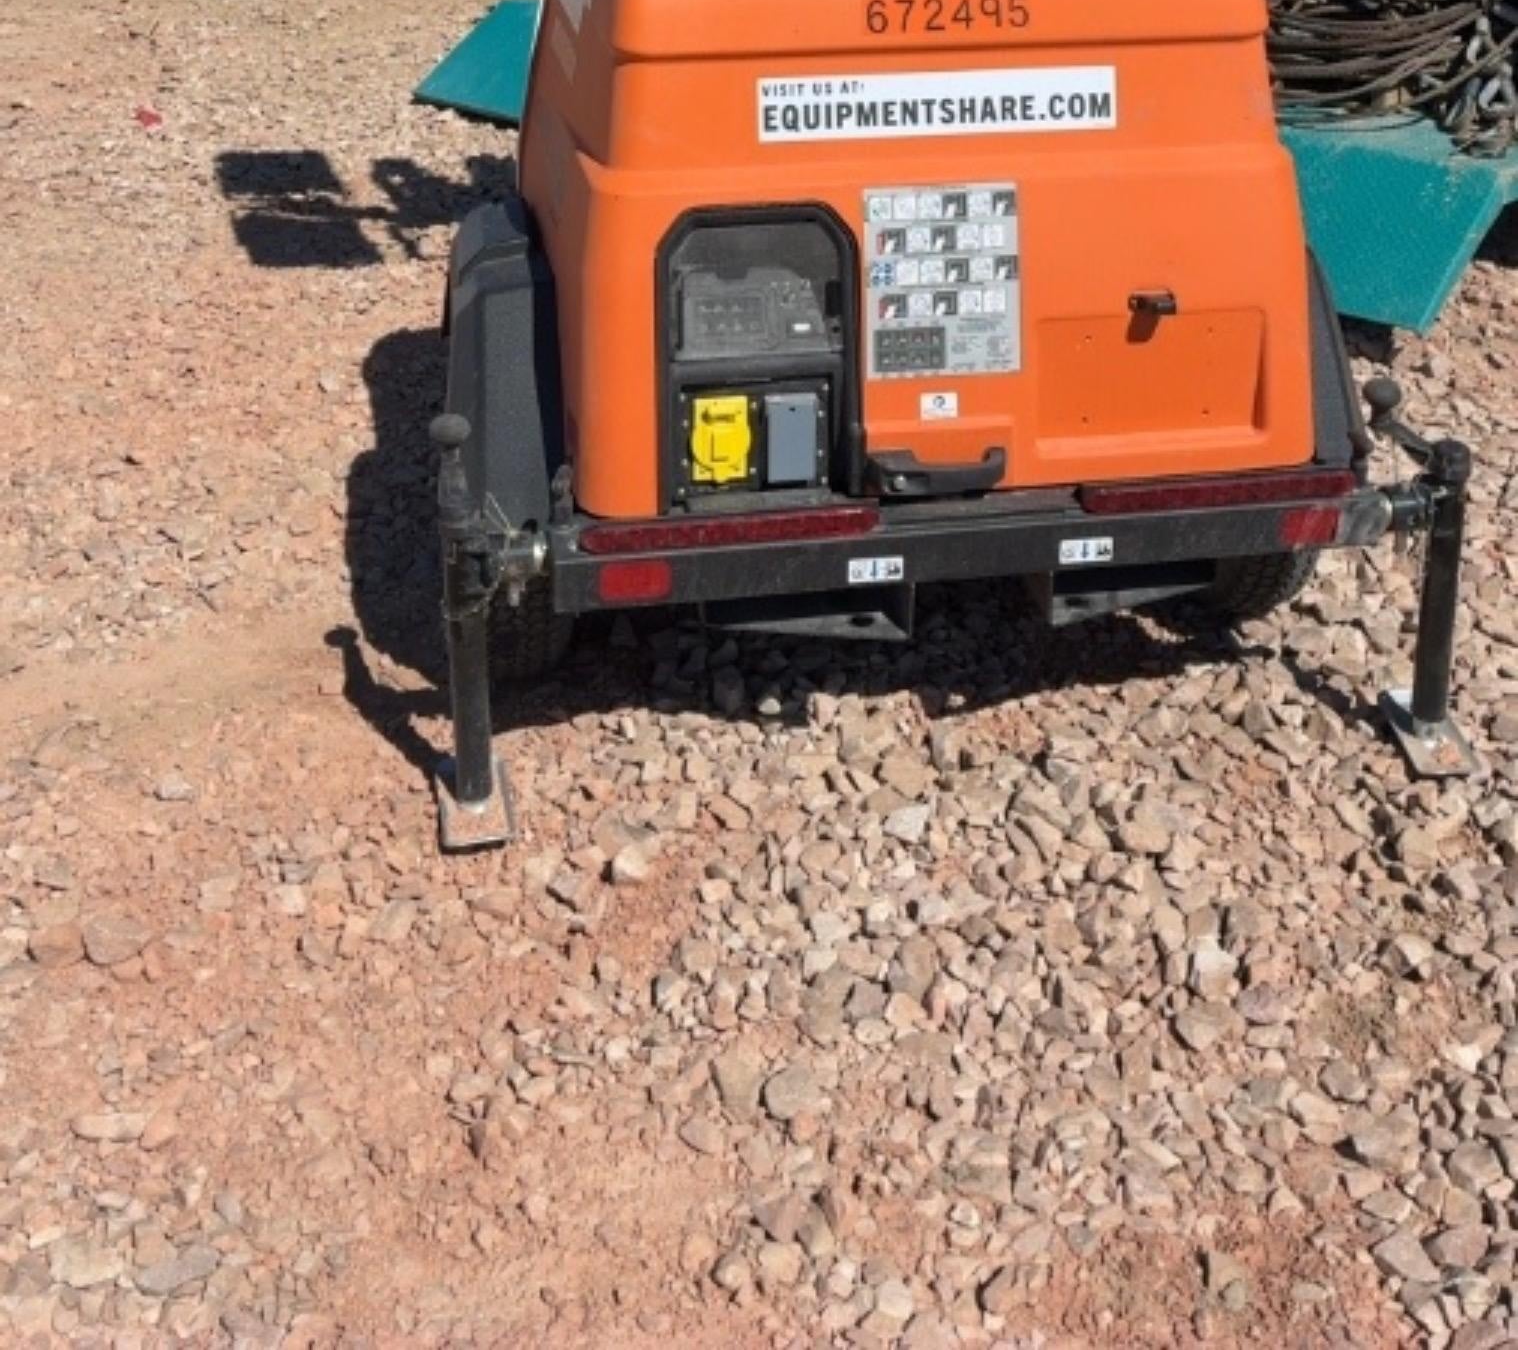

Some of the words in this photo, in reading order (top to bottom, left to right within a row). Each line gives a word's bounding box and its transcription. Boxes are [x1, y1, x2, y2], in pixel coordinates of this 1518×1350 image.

[761, 83, 805, 97] VISIT
[812, 82, 833, 96] US
[763, 92, 1112, 133] EQUIPMENTSHARE.COM
